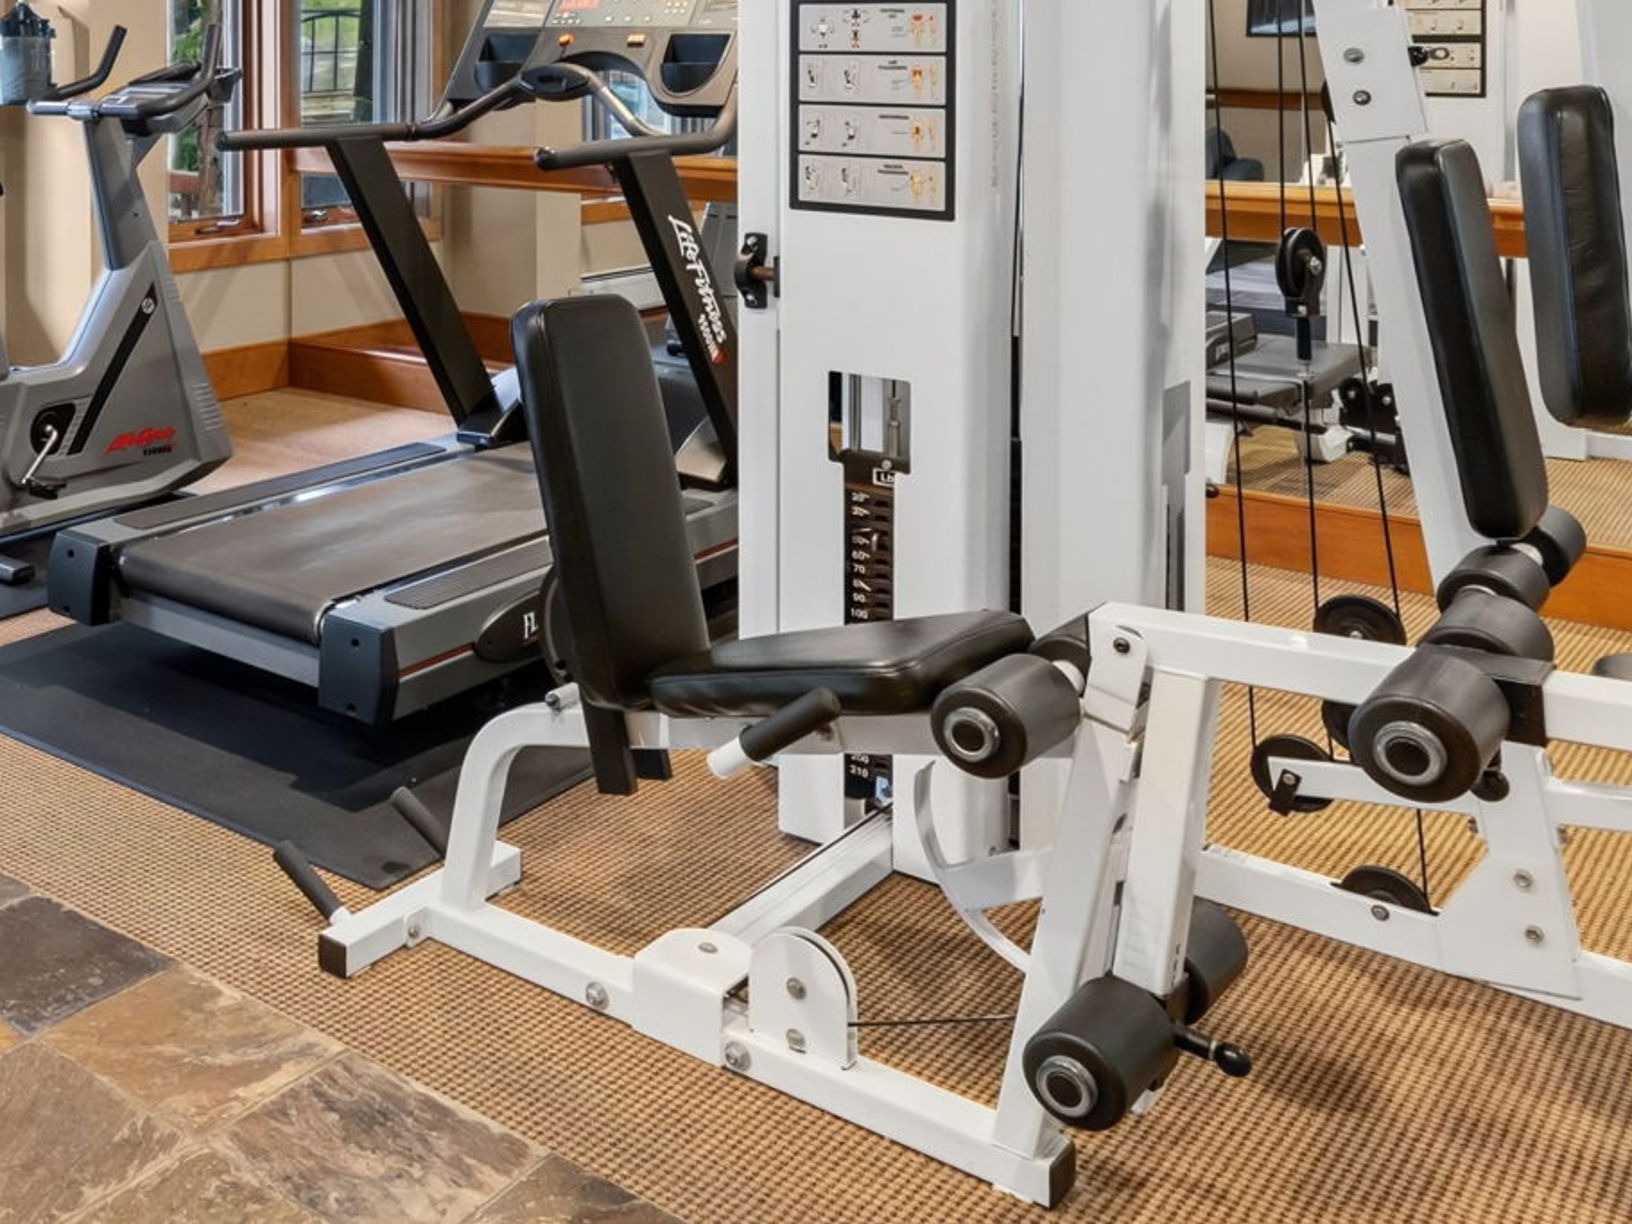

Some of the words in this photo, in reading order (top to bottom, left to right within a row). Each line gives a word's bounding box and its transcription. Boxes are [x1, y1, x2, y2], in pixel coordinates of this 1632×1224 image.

[853, 563, 866, 574] 70
[851, 608, 868, 619] 100
[849, 765, 869, 779] 210
